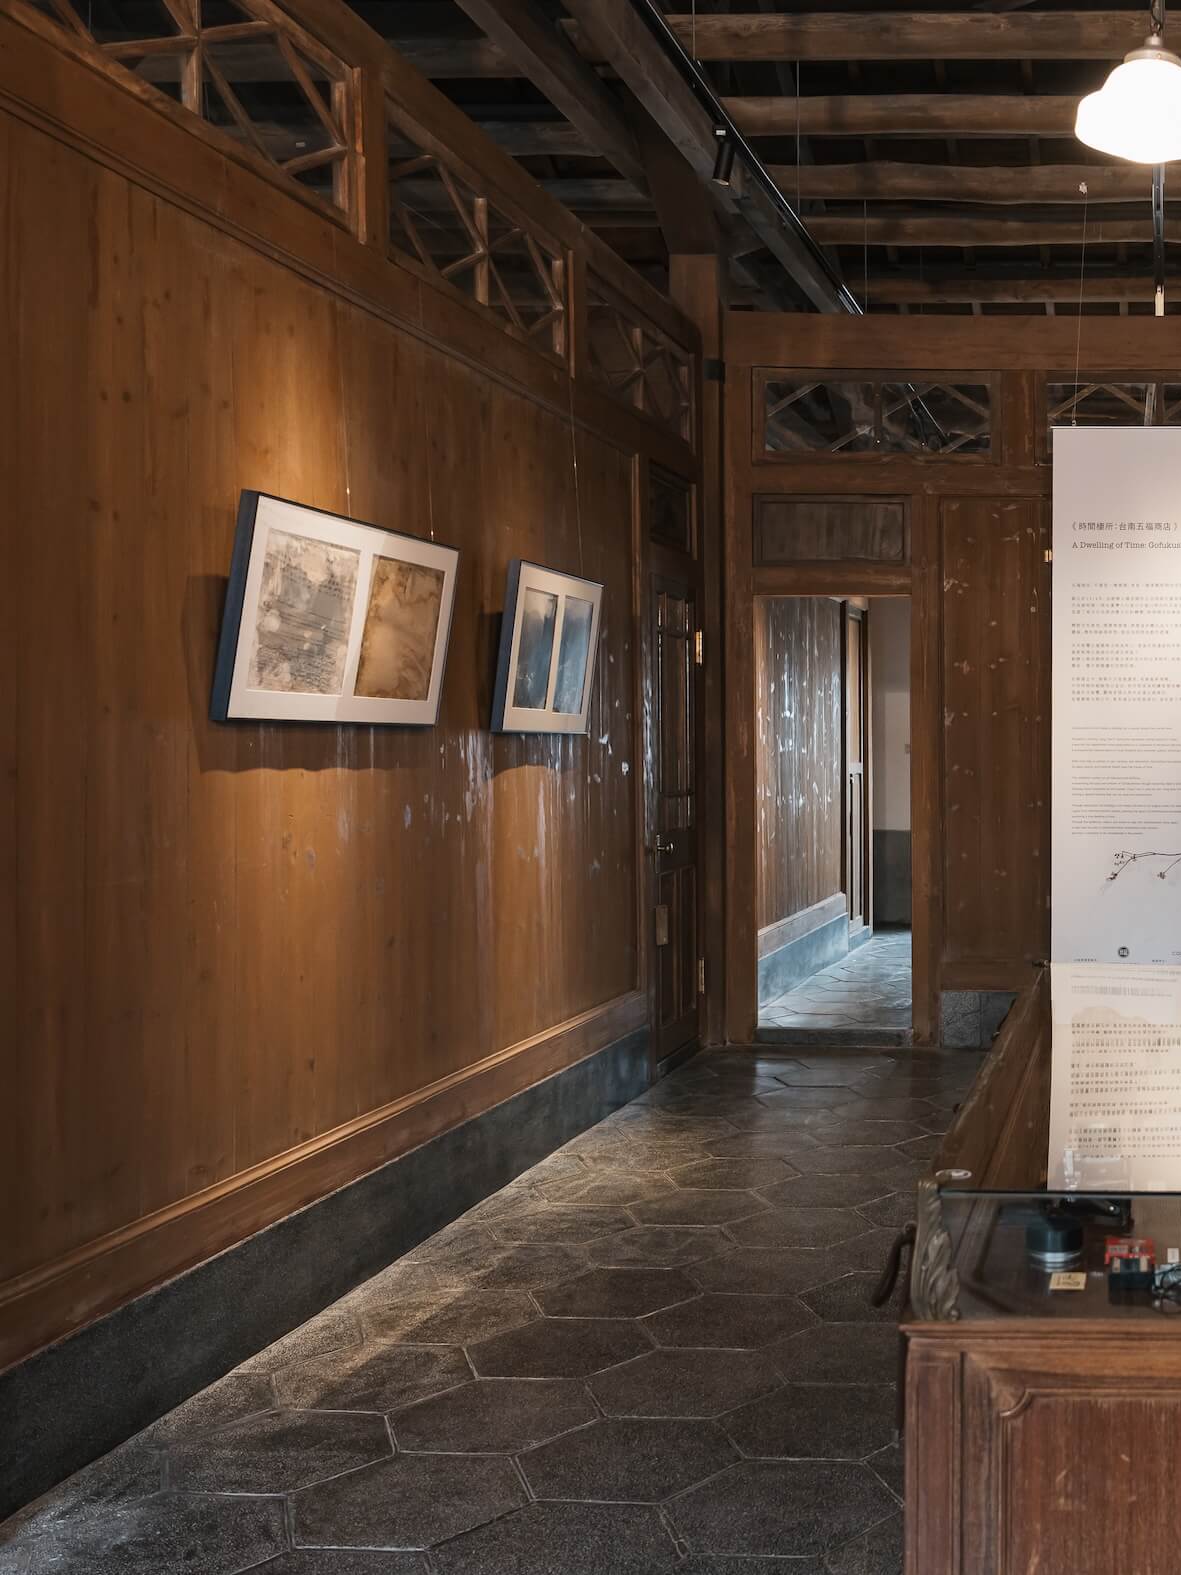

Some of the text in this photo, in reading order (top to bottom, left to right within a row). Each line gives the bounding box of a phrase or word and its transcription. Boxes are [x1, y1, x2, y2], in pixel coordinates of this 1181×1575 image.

[1072, 541, 1078, 549] A
[1079, 540, 1114, 551] Dwelling
[1115, 540, 1124, 549] of
